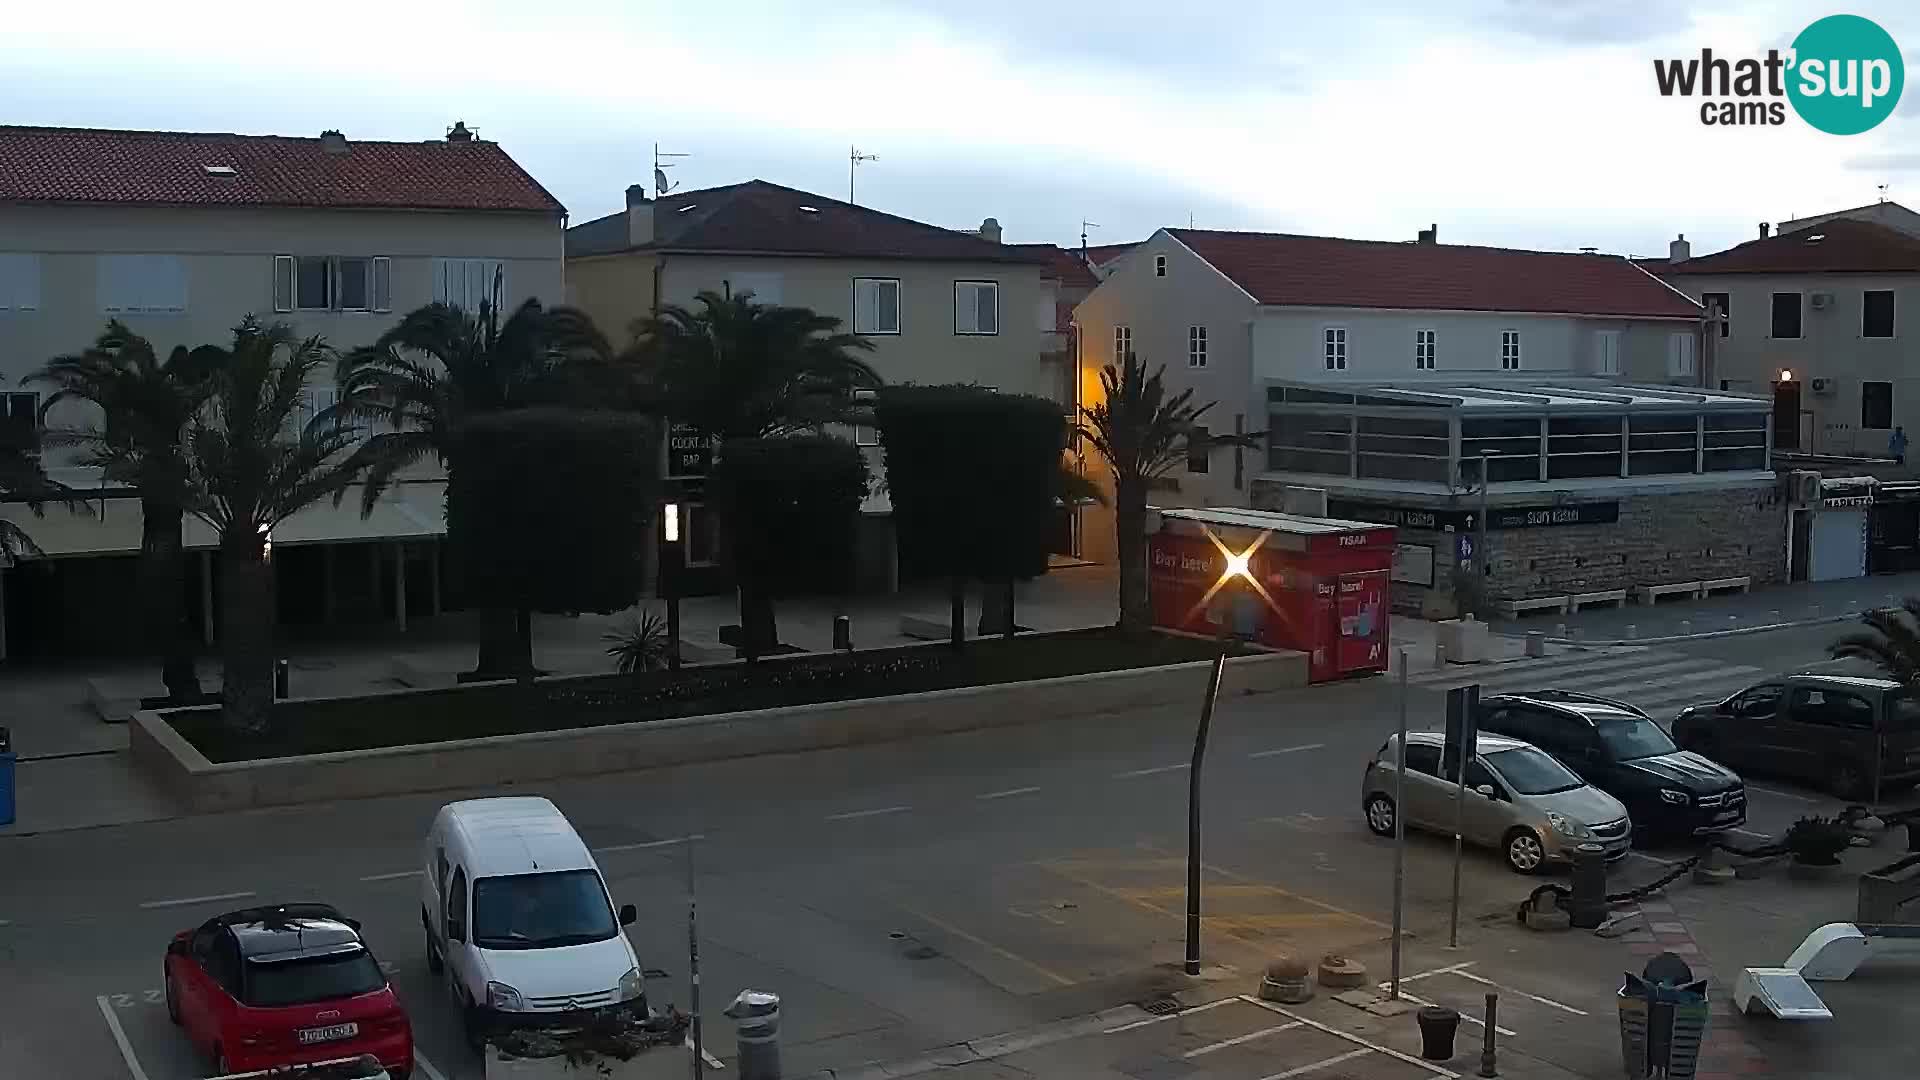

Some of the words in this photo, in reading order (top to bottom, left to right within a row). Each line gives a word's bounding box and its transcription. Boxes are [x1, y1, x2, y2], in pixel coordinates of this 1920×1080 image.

[683, 454, 700, 465] BAR
[1318, 582, 1336, 598] Buy
[1340, 579, 1364, 593] here!
